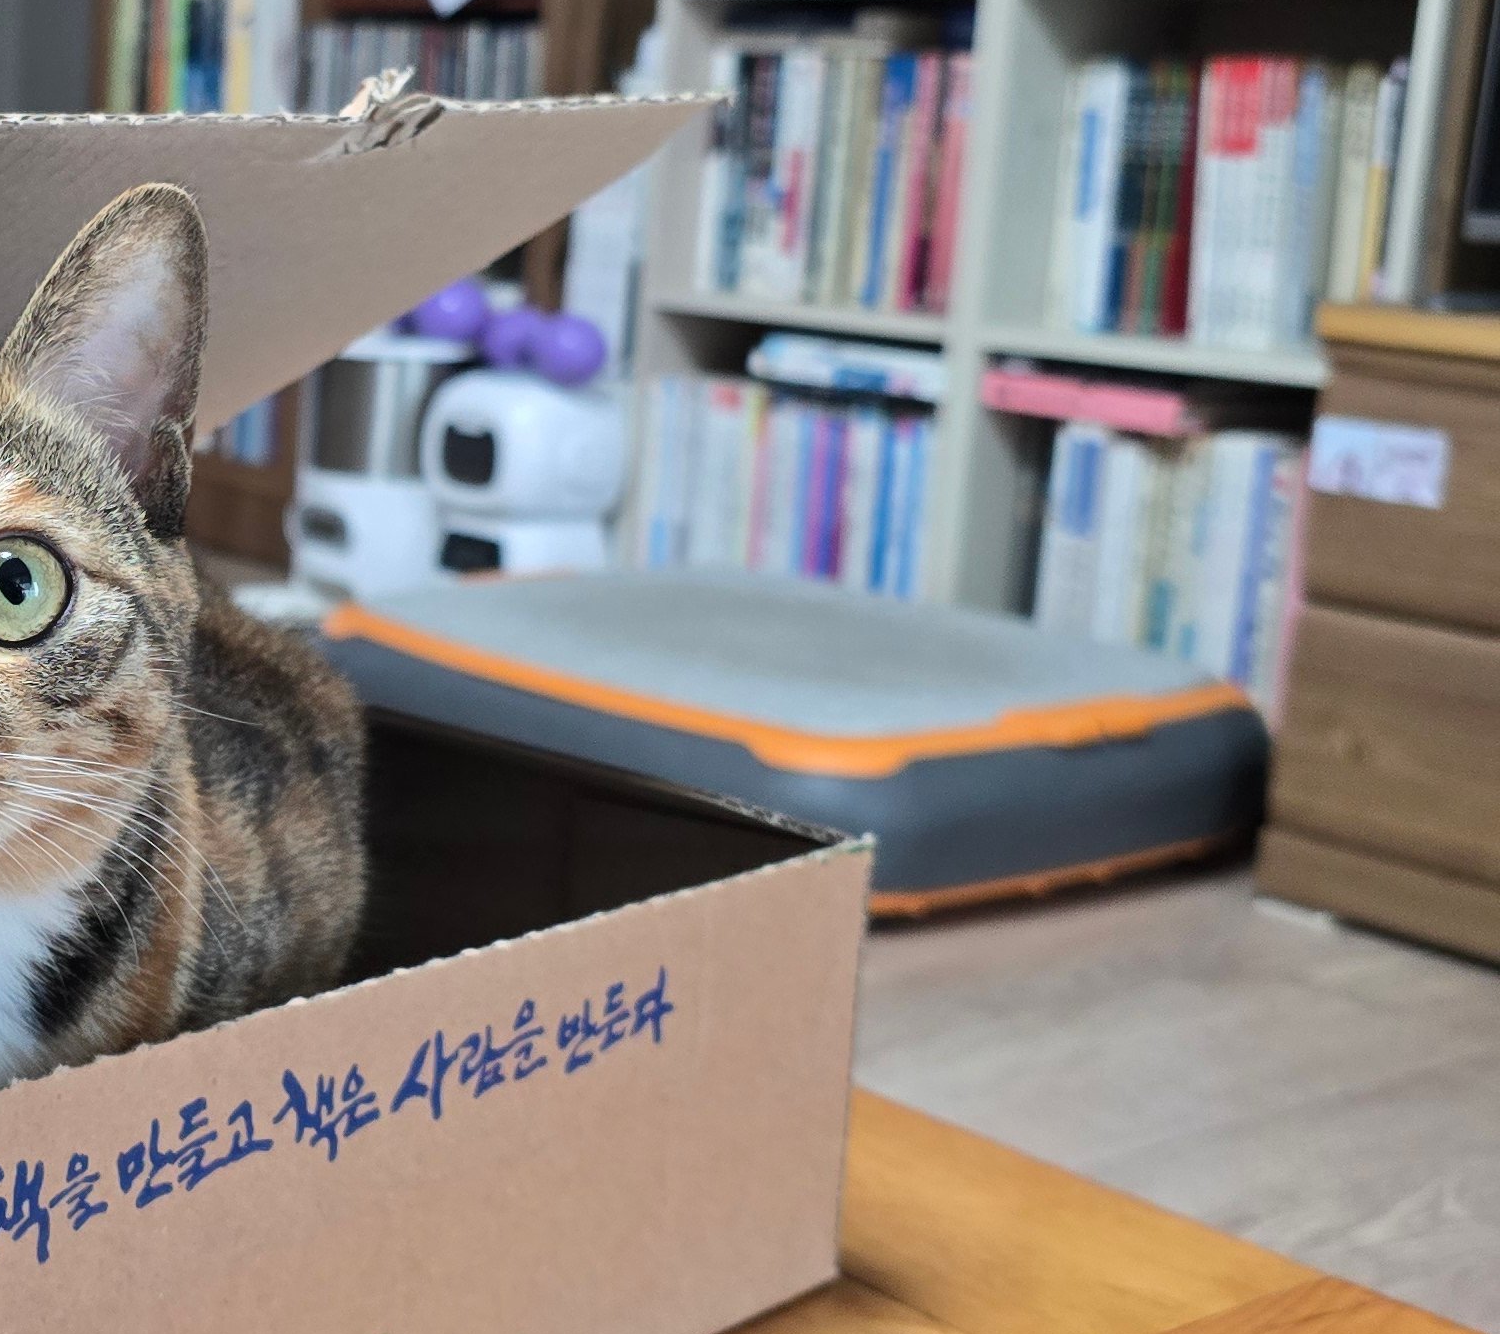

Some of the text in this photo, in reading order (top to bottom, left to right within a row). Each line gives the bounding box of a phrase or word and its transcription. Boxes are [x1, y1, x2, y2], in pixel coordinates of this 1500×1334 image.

[117, 1098, 274, 1209] 만들고
[273, 1064, 380, 1162] 책은
[390, 999, 548, 1120] 사람을
[556, 965, 674, 1074] 만든다
